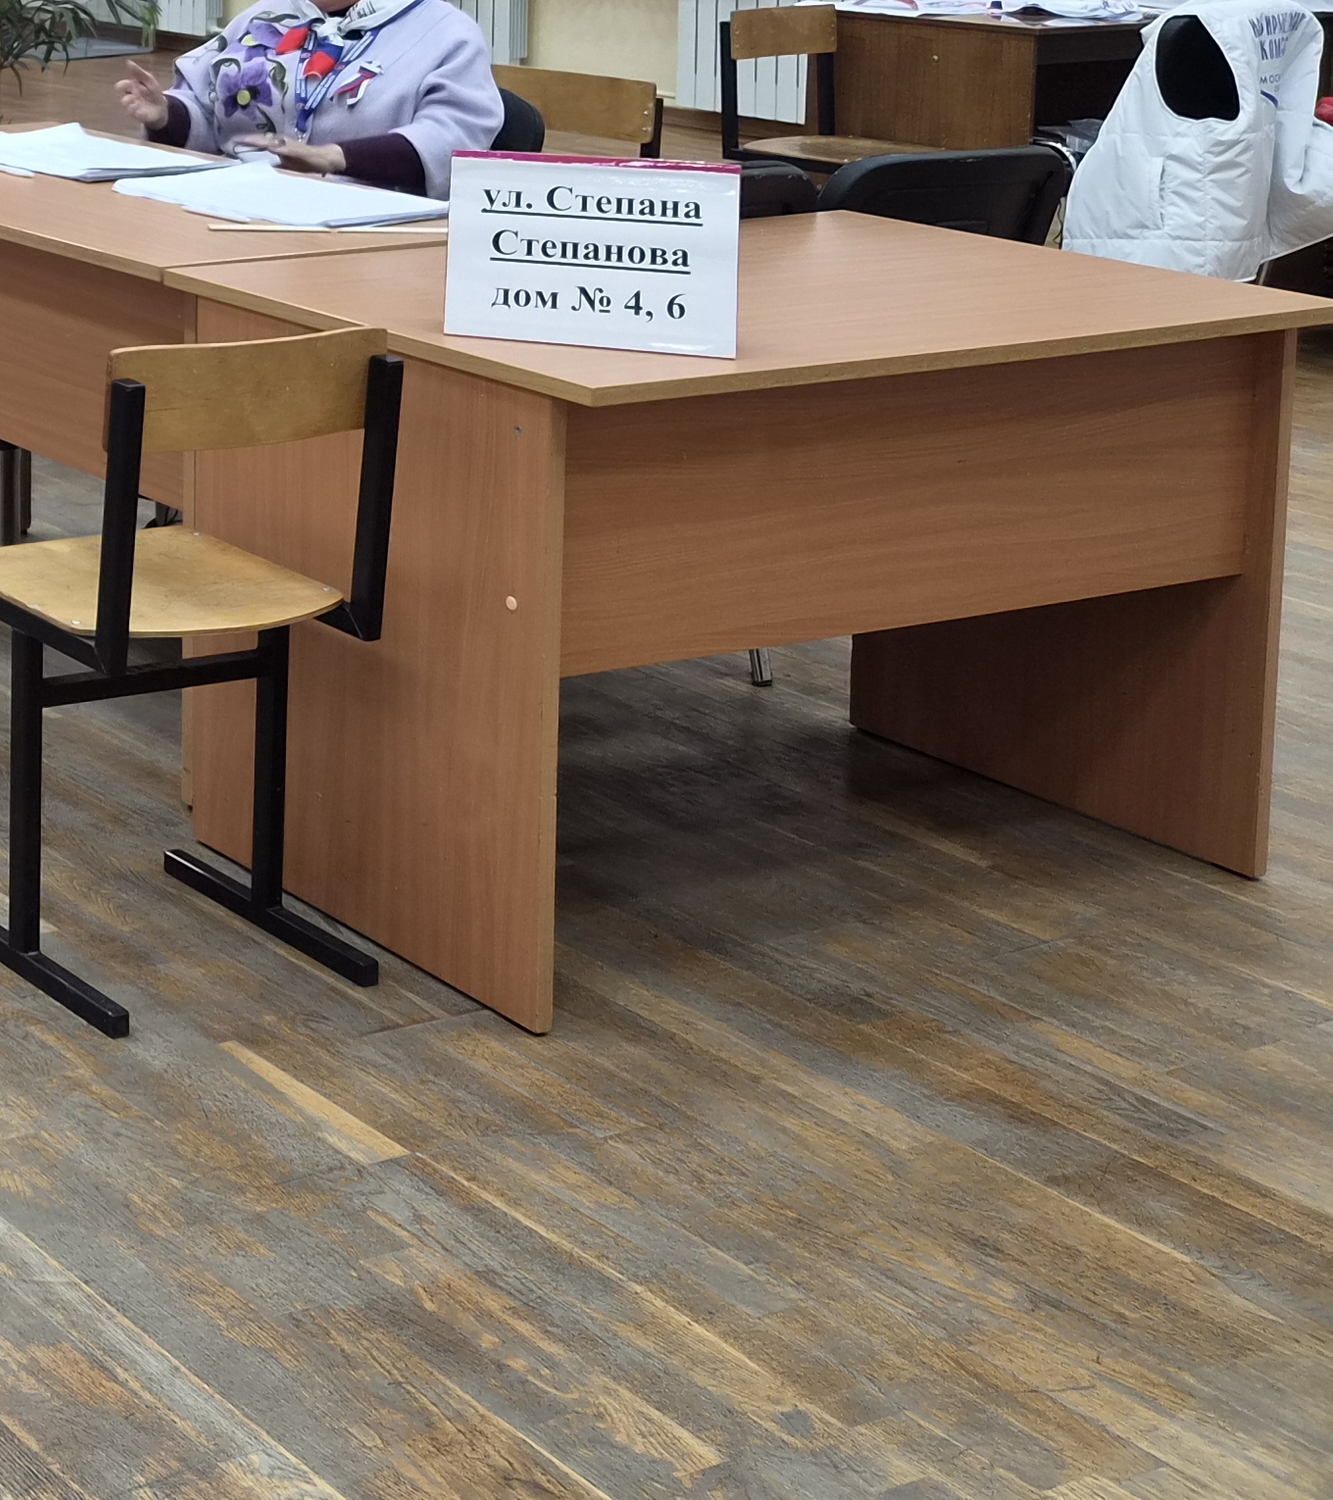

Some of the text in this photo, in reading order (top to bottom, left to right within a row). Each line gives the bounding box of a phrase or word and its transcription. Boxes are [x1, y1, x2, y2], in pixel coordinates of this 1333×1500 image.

[483, 185, 703, 220] ул. Степана
[491, 229, 690, 268] Степанова
[490, 285, 687, 322] дом № 4, 6
